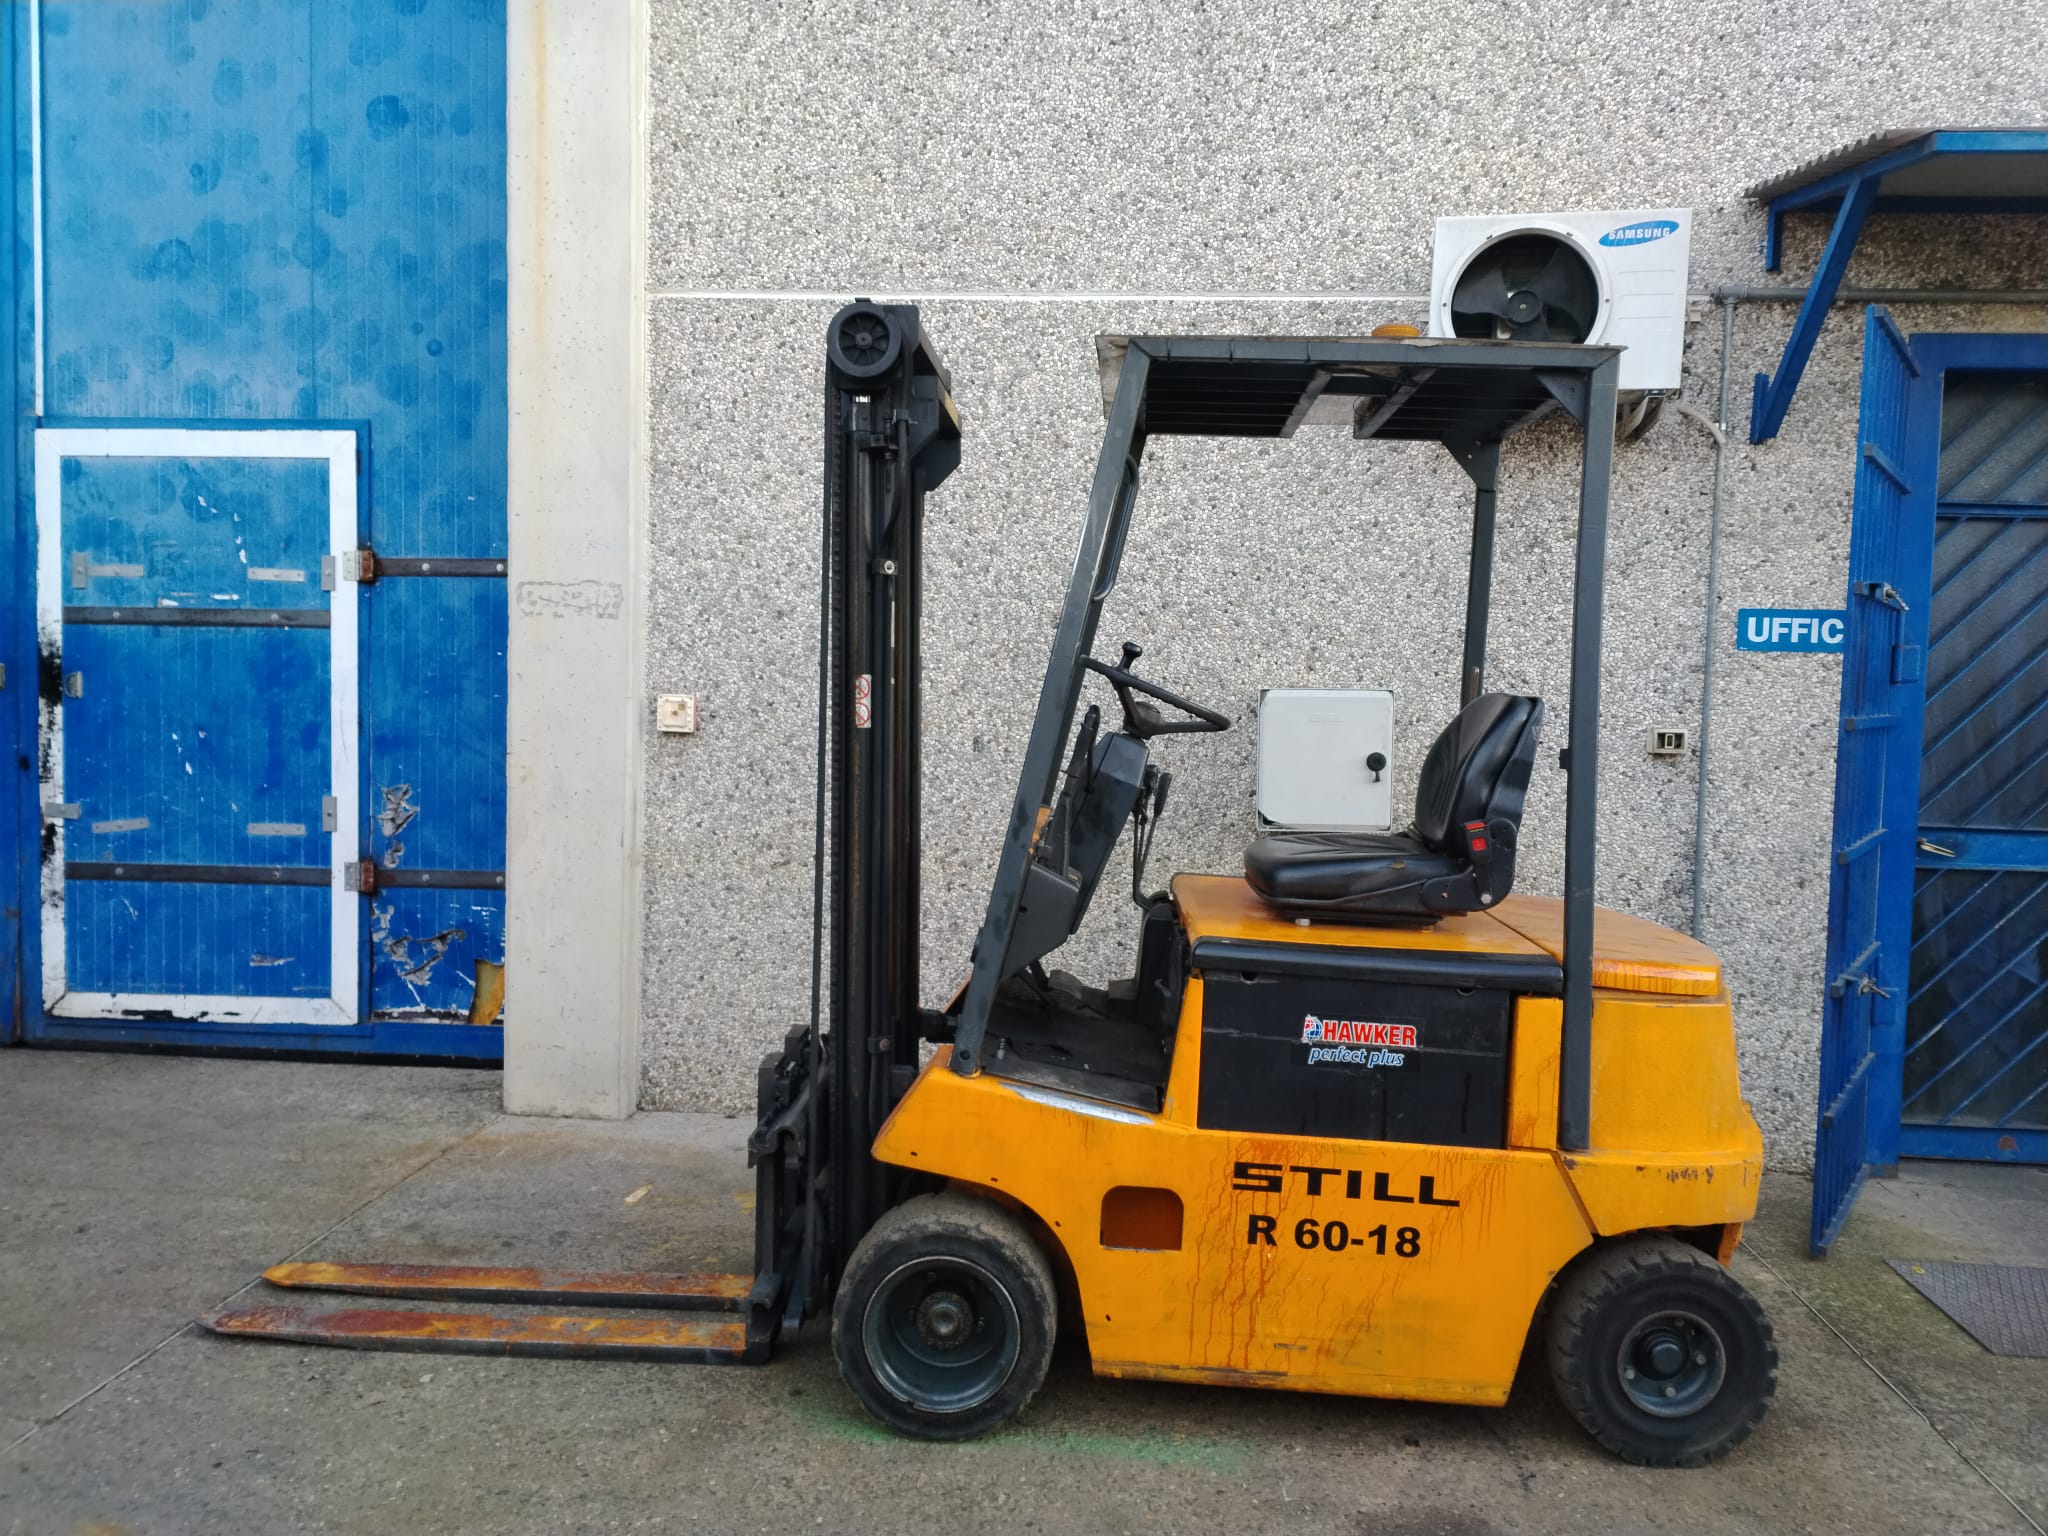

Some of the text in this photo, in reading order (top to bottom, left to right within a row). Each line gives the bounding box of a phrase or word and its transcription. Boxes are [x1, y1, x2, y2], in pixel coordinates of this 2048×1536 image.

[1608, 227, 1671, 240] SAMSUNG
[1747, 617, 1844, 643] UFFIC
[1322, 1019, 1417, 1047] HAWKER
[1308, 1046, 1405, 1068] perfect plus
[1232, 1161, 1460, 1207] STILL
[1247, 1213, 1421, 1258] R 60-18
